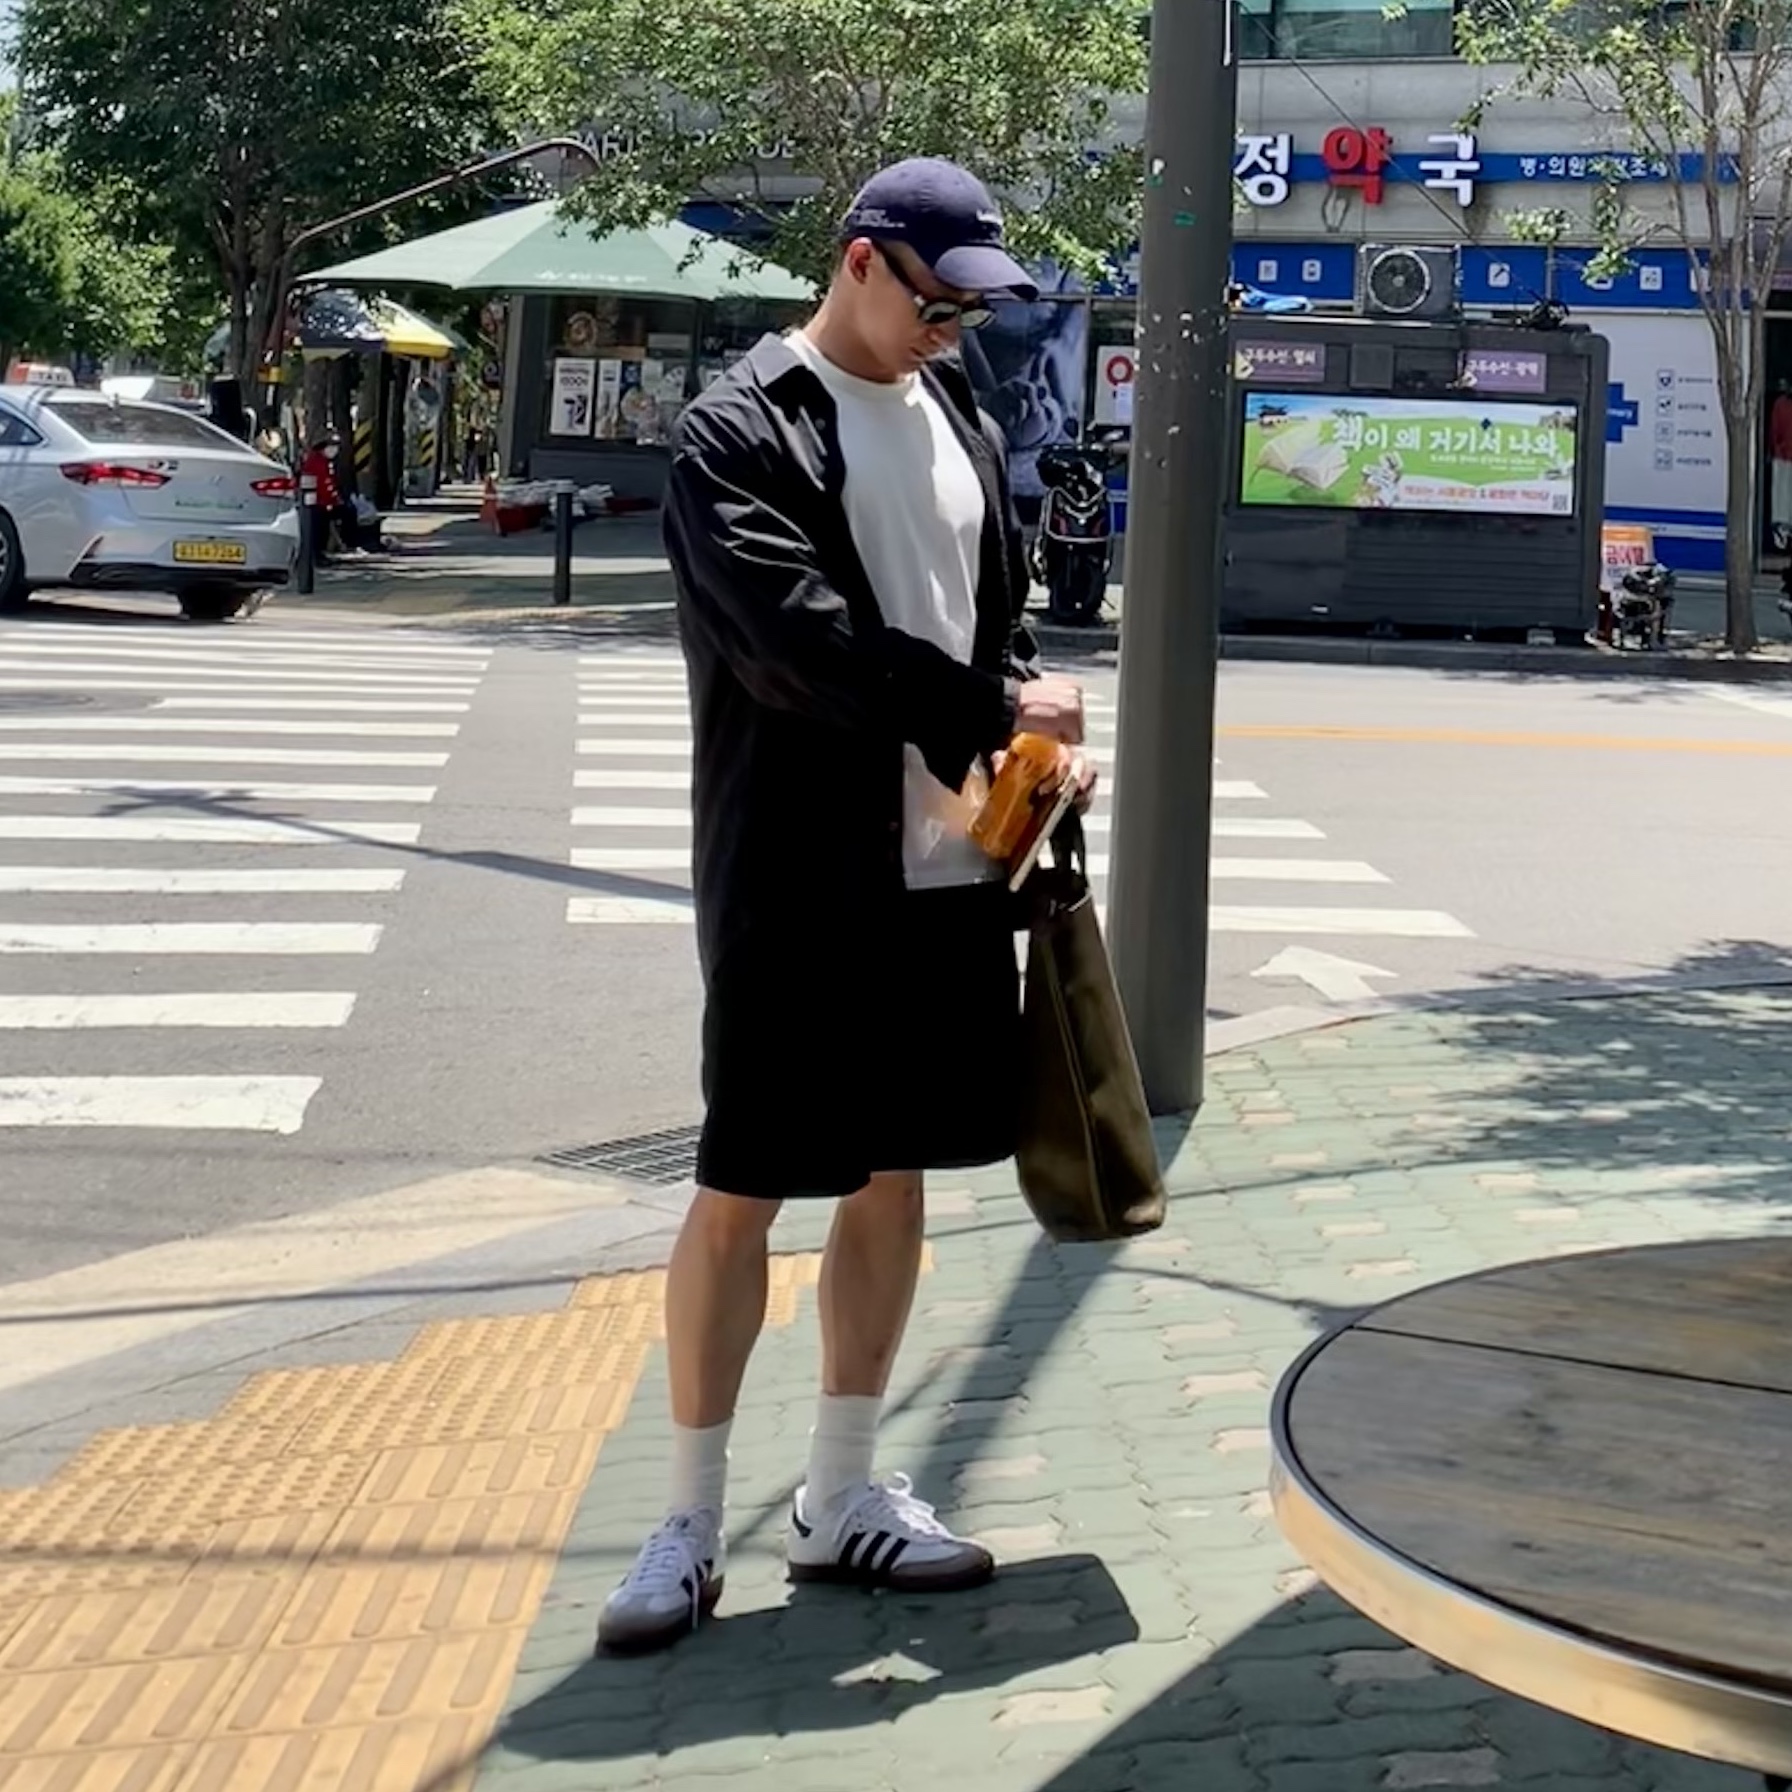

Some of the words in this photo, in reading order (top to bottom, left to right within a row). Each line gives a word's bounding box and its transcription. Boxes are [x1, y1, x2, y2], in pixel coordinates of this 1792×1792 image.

[1333, 415, 1388, 452] 책이
[1394, 426, 1421, 452] 왜
[1429, 427, 1501, 454] 거기서
[1509, 430, 1558, 457] 나와
